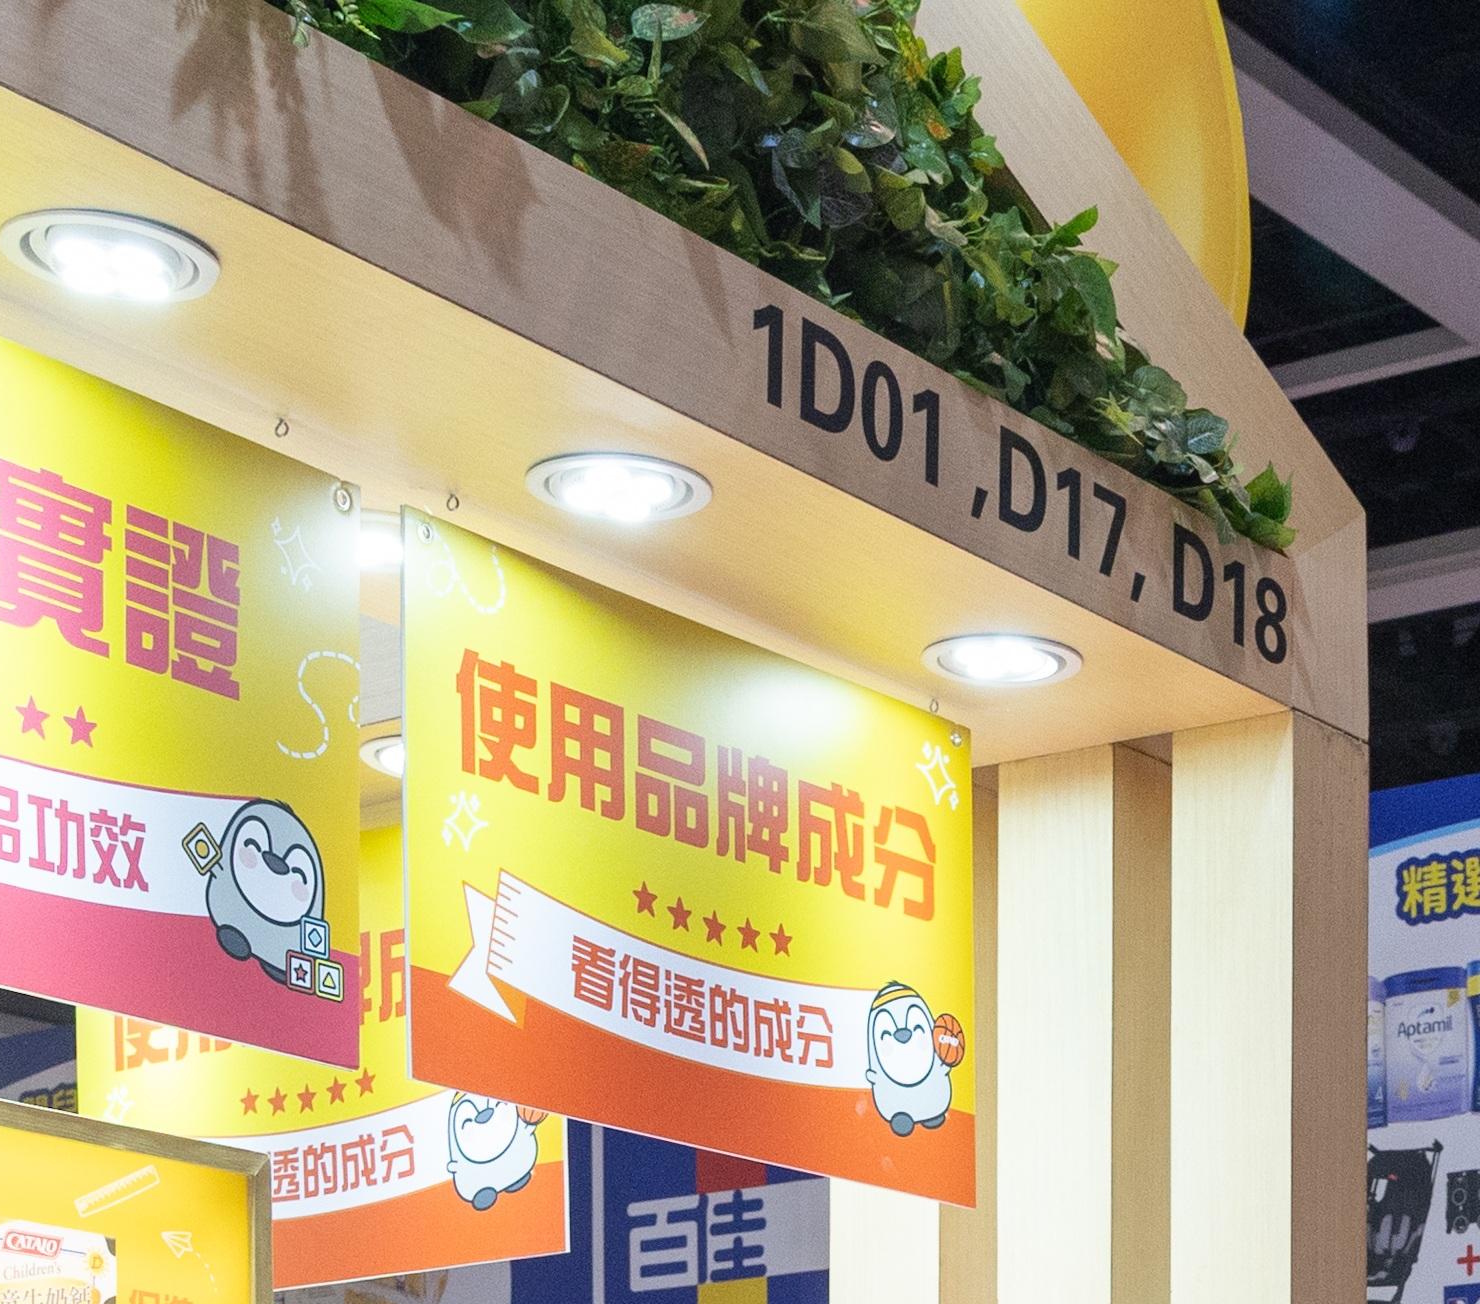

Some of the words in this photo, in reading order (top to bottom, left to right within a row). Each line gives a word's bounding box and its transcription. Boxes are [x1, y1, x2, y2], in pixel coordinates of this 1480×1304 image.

[753, 304, 941, 487] 1D01
[1173, 522, 1287, 664] D18
[455, 647, 937, 922] 使用品牌成分
[570, 934, 835, 1069] 看得透的成分
[1397, 1016, 1454, 1038] Aptamil
[3, 1261, 62, 1282] Children's
[5, 1232, 61, 1256] CATALO
[627, 1186, 767, 1293] 百佳
